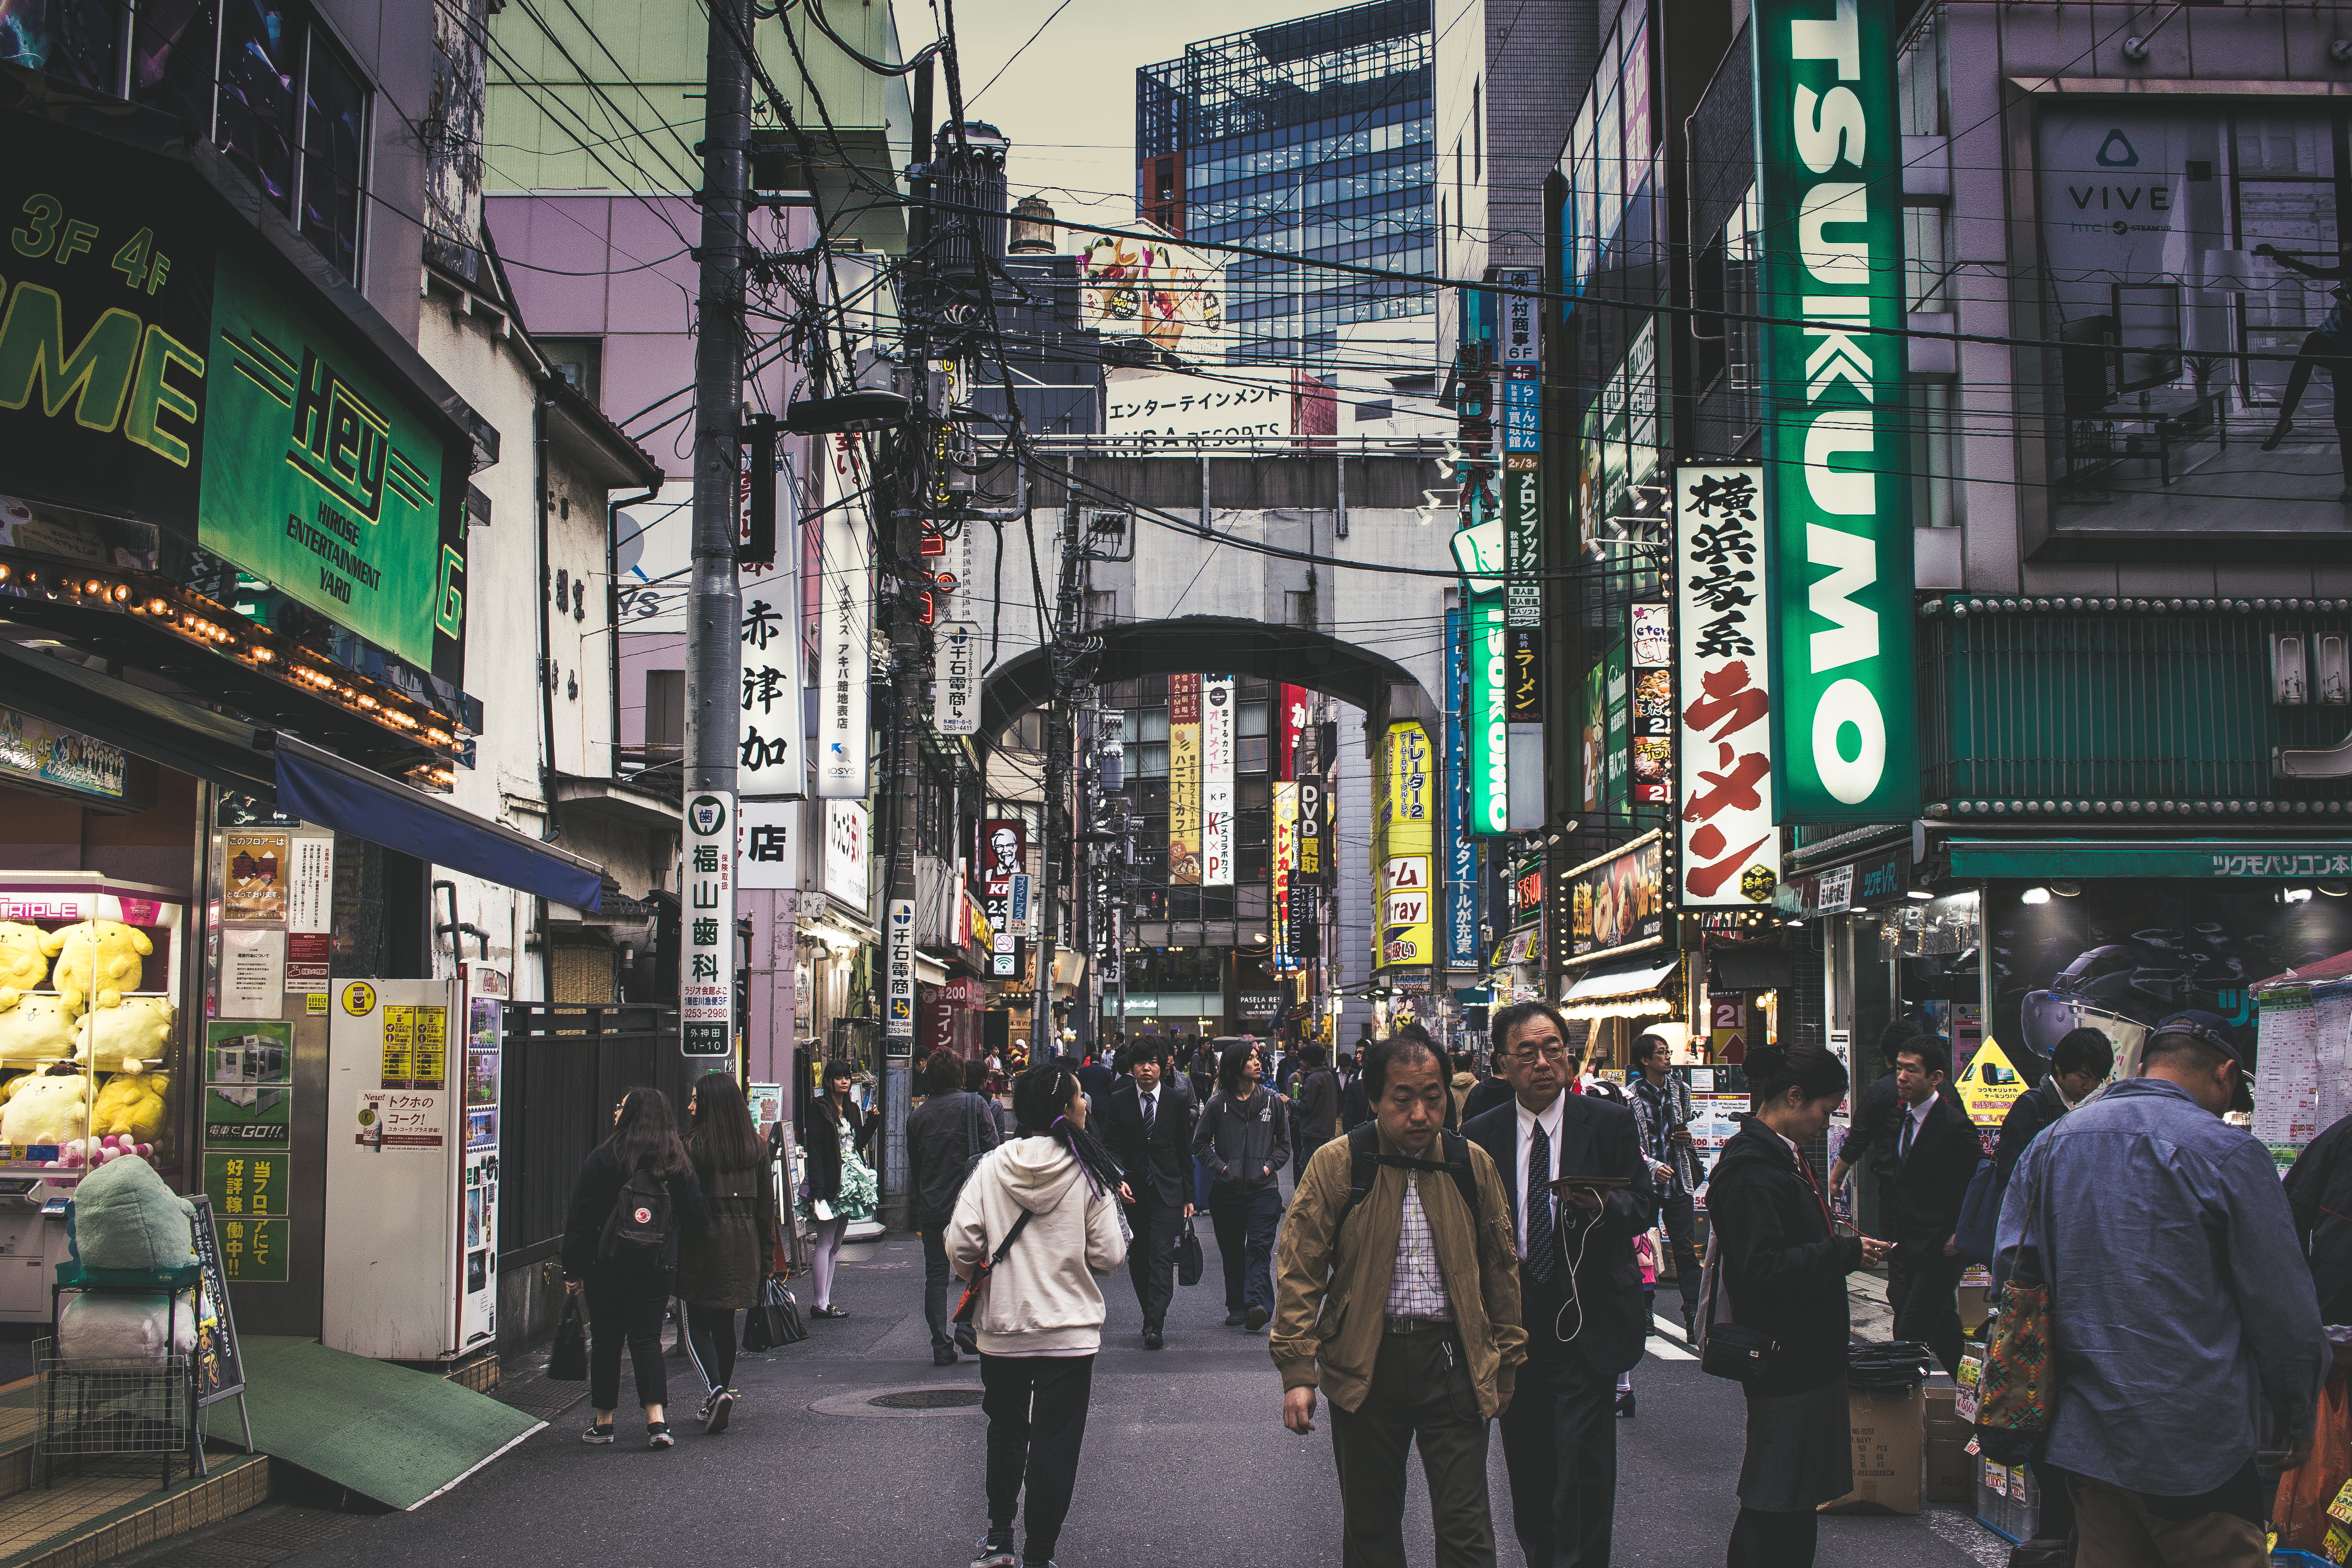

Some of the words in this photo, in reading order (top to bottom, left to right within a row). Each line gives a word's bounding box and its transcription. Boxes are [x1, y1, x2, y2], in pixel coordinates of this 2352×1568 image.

[2068, 186, 2170, 210] VIVE
[12, 193, 99, 265] 3F
[112, 227, 171, 295] 4F
[1509, 348, 1532, 359] 6F
[1512, 366, 1530, 379] 4F
[0, 281, 205, 468] ME
[1109, 386, 1280, 419] エンターテインメント
[1791, 6, 1887, 804] TSUKUMO
[286, 344, 391, 525] Hey
[1508, 458, 1538, 469] 2F/3F
[317, 500, 361, 547] HIROSE
[287, 513, 382, 591] ENTERTAINMENT
[319, 566, 352, 606] YARD
[739, 600, 788, 771] 赤津加
[836, 645, 851, 729] アキバ路地表店
[949, 646, 967, 707] 千石電商
[1514, 649, 1535, 710] ラーメン
[1209, 710, 1220, 774] オトメイト
[1408, 731, 1425, 819] トレーダー2
[699, 808, 714, 824] 歯
[1175, 756, 1186, 838] ハニトーカフェ
[229, 837, 285, 846] このフロアーは
[748, 824, 786, 863] 店
[1301, 785, 1320, 873] DVD買取
[1743, 874, 1773, 891] 壱角家
[2213, 855, 2352, 875] ツクモパソコン本
[988, 883, 1009, 894] KF
[1015, 876, 1026, 920] コスメイトプラス
[692, 844, 719, 983] 福山歯科
[1292, 888, 1301, 954] ROOMPIA
[891, 928, 910, 994] 千石電商
[685, 986, 728, 995] ラジオ会館よこ
[938, 987, 966, 999] ¥200
[684, 1008, 728, 1018] 3253-2980
[690, 1028, 720, 1038] 外神田
[938, 1005, 952, 1045] コイン
[692, 1041, 721, 1050] 1-10
[388, 1113, 426, 1125] コーク!
[389, 1096, 434, 1108] トクホの
[1971, 1101, 2015, 1110] お持ち帰り
[253, 1160, 271, 1265] 当フロアにて
